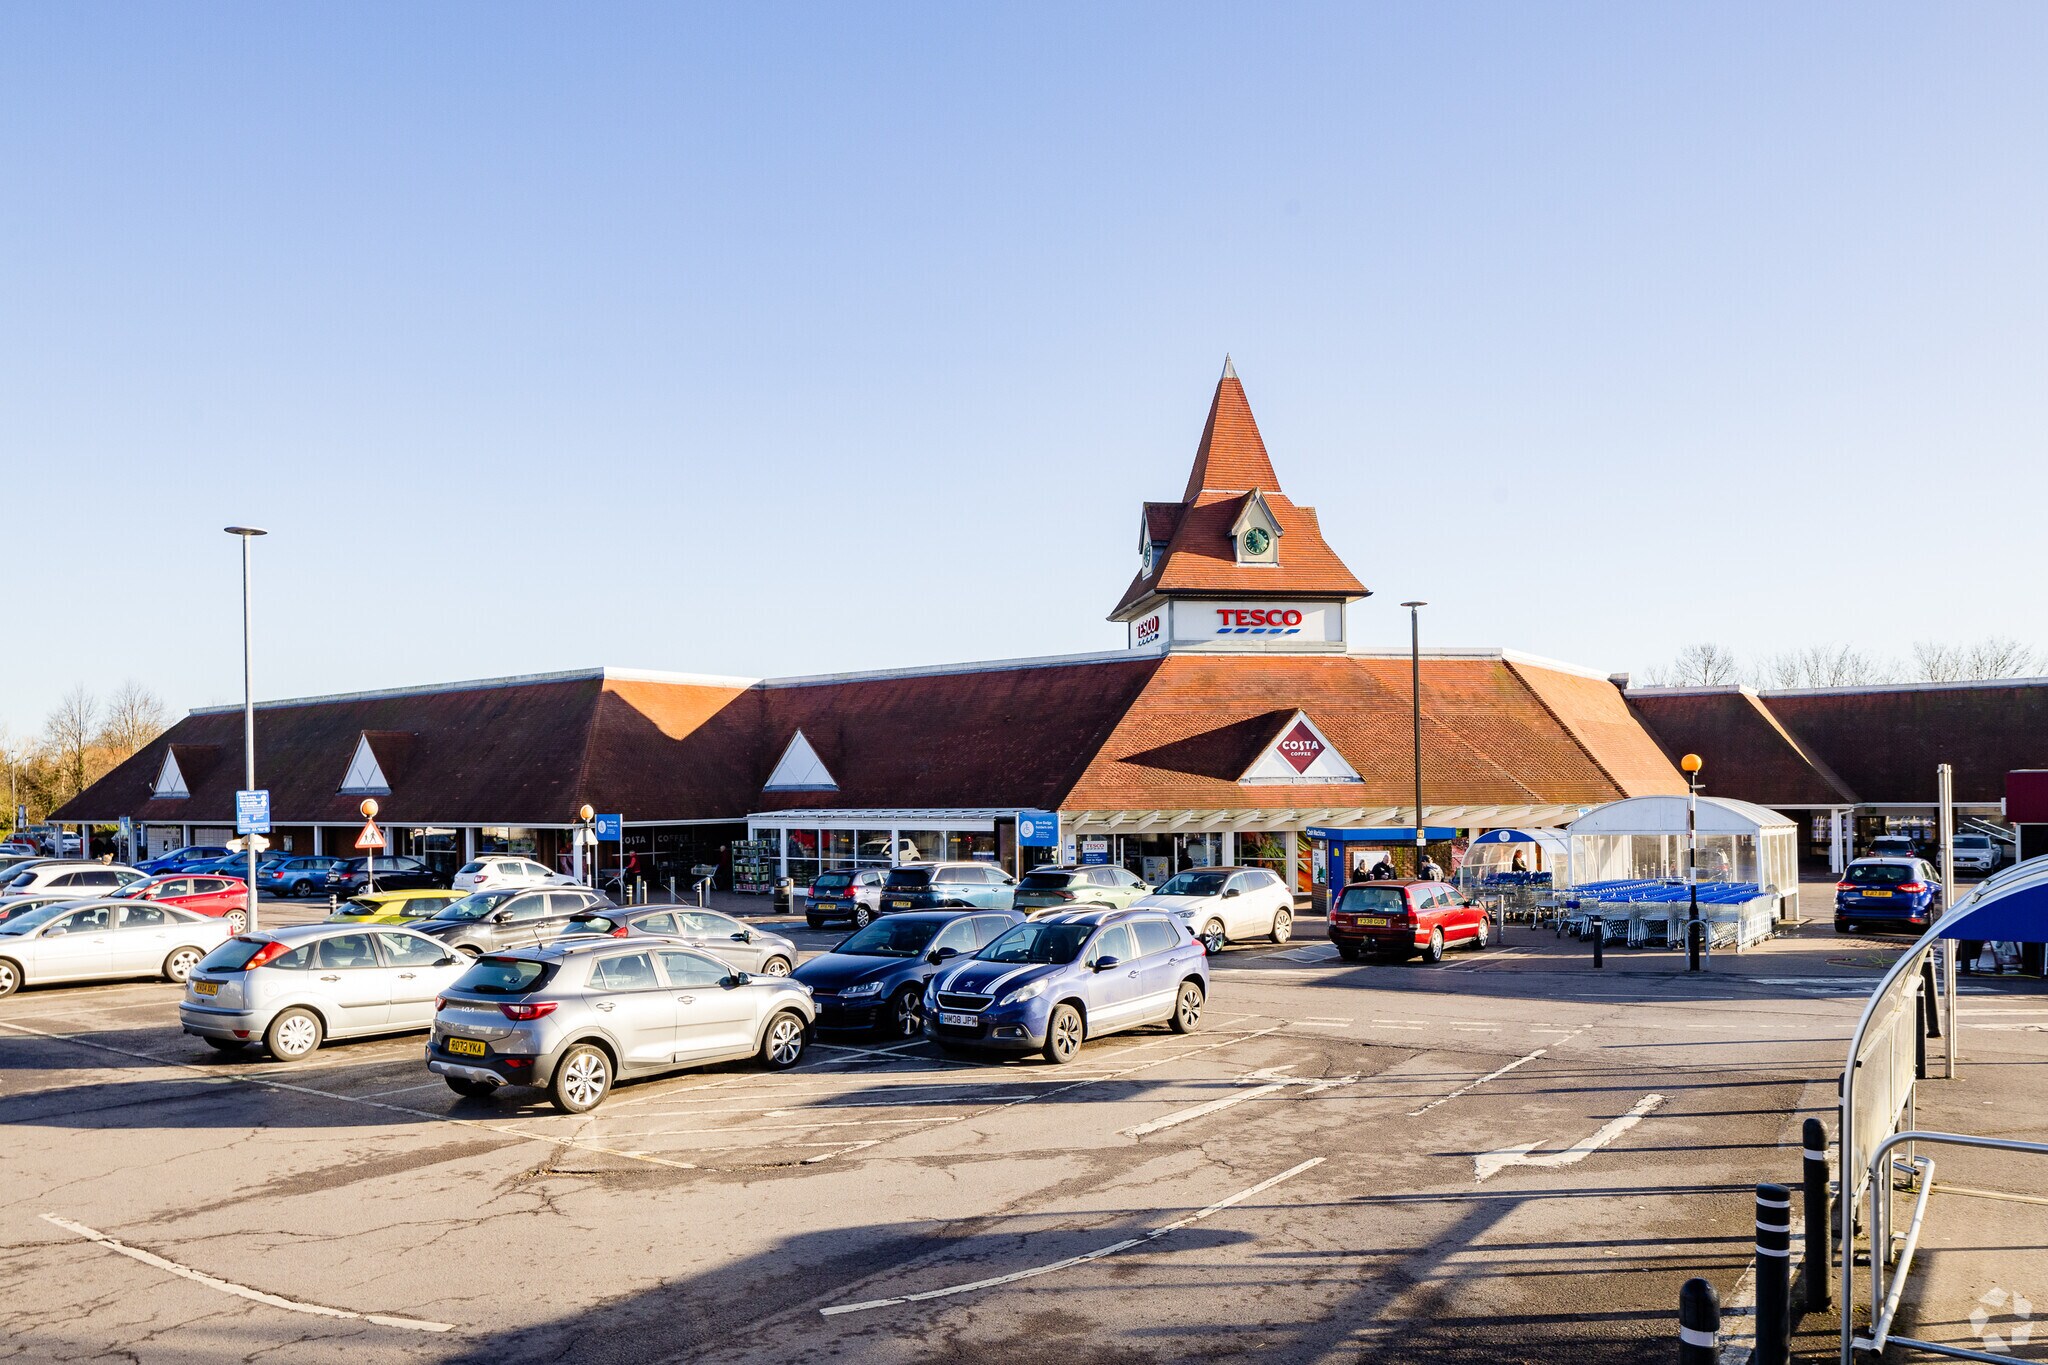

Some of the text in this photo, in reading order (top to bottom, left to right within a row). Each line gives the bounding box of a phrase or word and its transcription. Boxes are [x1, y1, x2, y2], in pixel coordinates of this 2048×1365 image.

[1216, 609, 1303, 627] TESCO
[1136, 615, 1160, 639] TESCO
[1282, 740, 1319, 751] COSTA
[657, 834, 688, 843] COFFEE
[468, 1042, 482, 1054] YKA
